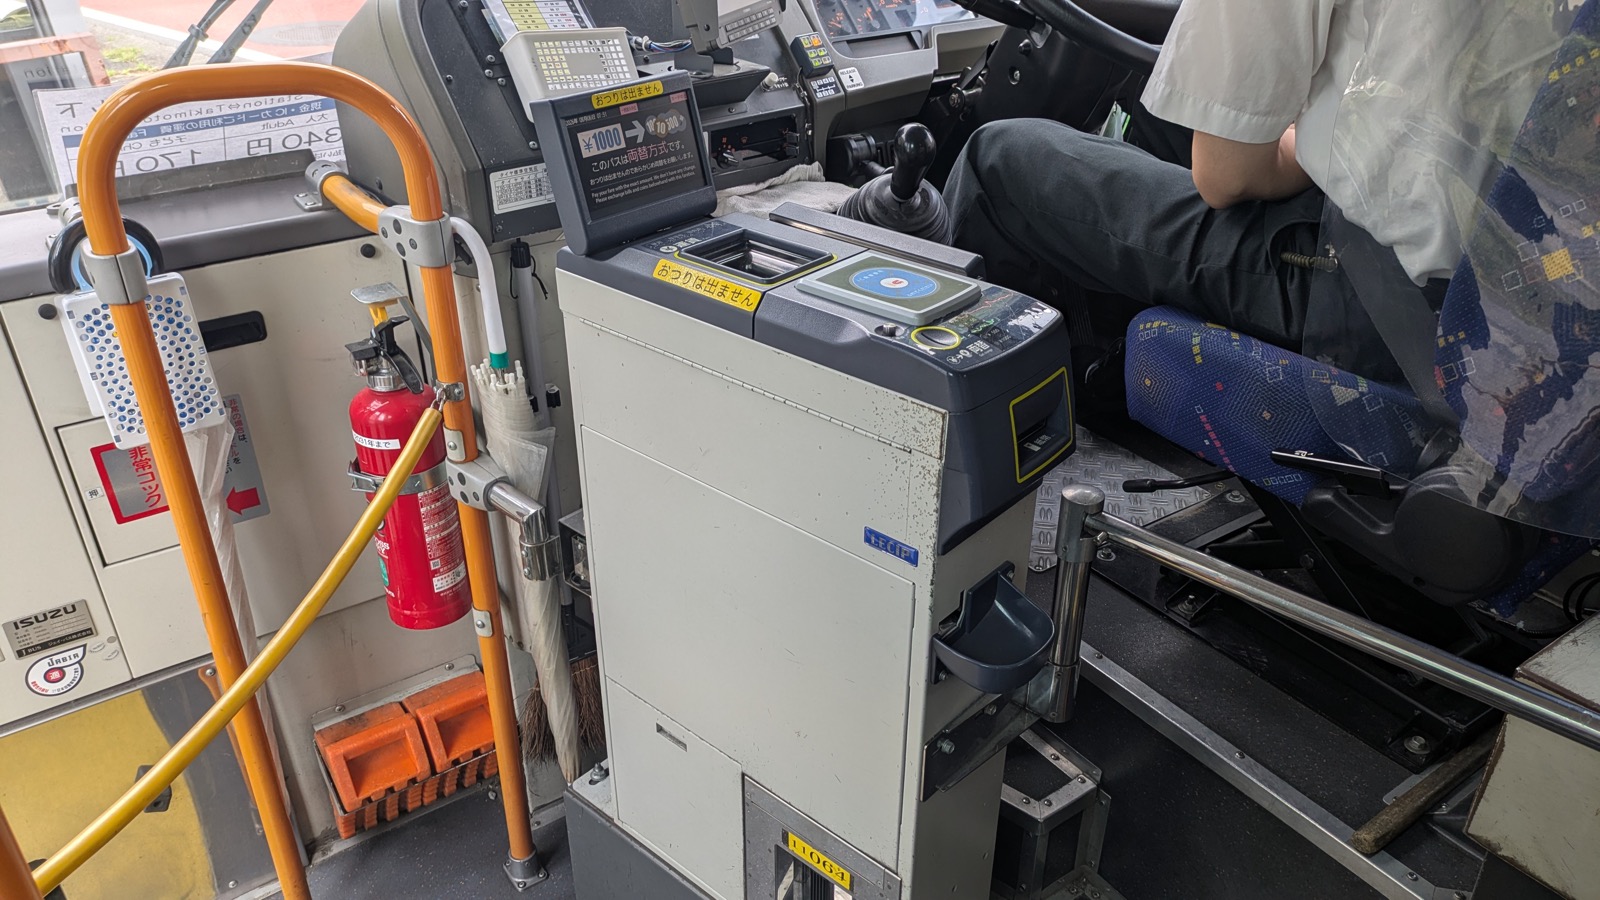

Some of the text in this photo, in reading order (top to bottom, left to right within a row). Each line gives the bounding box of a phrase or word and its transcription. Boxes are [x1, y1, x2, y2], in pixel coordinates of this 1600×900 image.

[595, 83, 661, 106] おつりは出ません
[582, 128, 621, 152] ¥1000
[655, 121, 666, 134] 10
[591, 140, 685, 172] このバスは両替方式です。
[657, 263, 754, 307] おつりは出ません
[128, 446, 161, 508] 非常コック
[869, 532, 911, 560] LECIP
[13, 604, 77, 630] ISUZU
[790, 838, 848, 883] 11064
